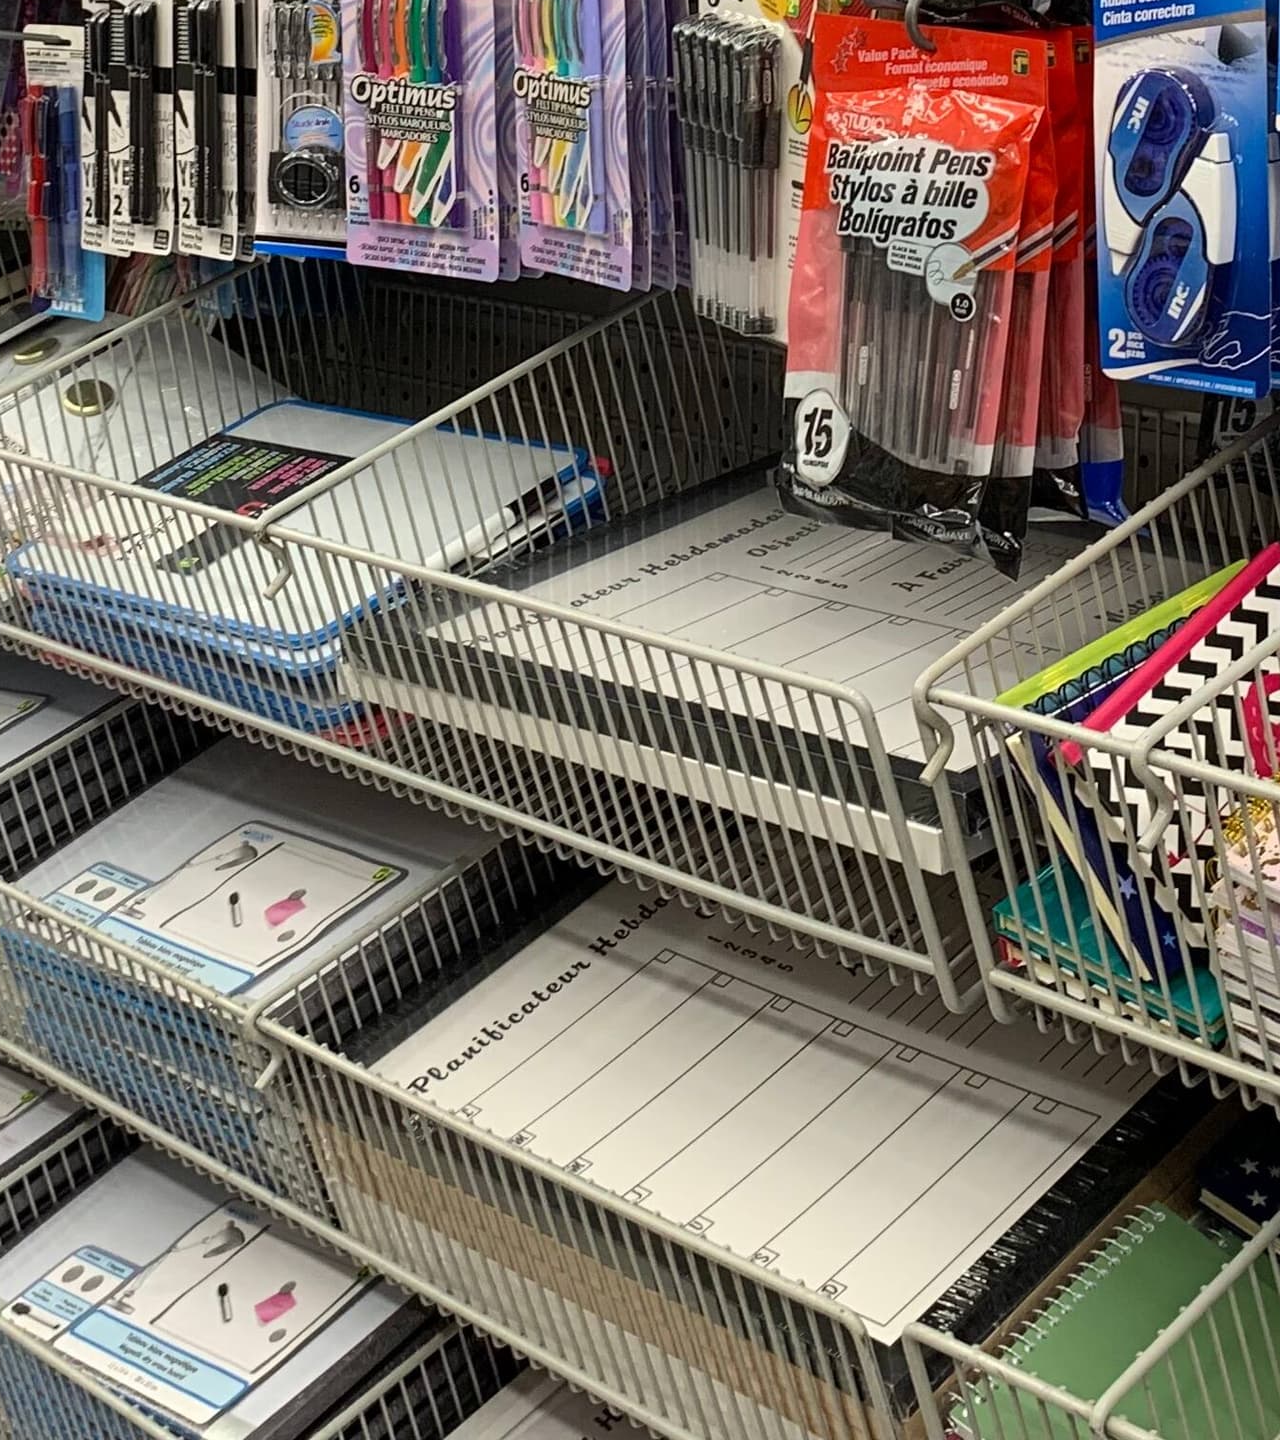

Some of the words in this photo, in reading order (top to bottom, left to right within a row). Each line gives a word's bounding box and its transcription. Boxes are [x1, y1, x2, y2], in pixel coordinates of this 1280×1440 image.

[1103, 10, 1131, 26] Cinta
[1134, 3, 1195, 23] correctora
[858, 49, 888, 62] Value
[892, 47, 918, 60] Pack
[885, 62, 922, 75] Format
[925, 58, 988, 72] économique
[351, 75, 457, 109] Optimus
[512, 70, 591, 105] Optimus
[953, 74, 1008, 87] económico
[381, 103, 398, 115] FELT
[368, 114, 398, 128] STYLOS
[399, 116, 451, 132] MARQUEURS
[381, 128, 438, 144] MARCADORES
[827, 143, 924, 175] Ballpoint
[930, 149, 991, 176] Pens
[349, 175, 360, 193] 6
[521, 174, 529, 192] 6
[832, 174, 896, 205] Stylos
[901, 179, 918, 203] à
[923, 181, 977, 208] bille
[839, 205, 956, 242] Bolígrafos
[956, 298, 969, 309] 1.0
[1109, 328, 1126, 358] 2
[805, 407, 833, 458] 15
[639, 508, 787, 577] Hebdomada
[748, 518, 826, 559] Objecti
[924, 555, 972, 584] Fair
